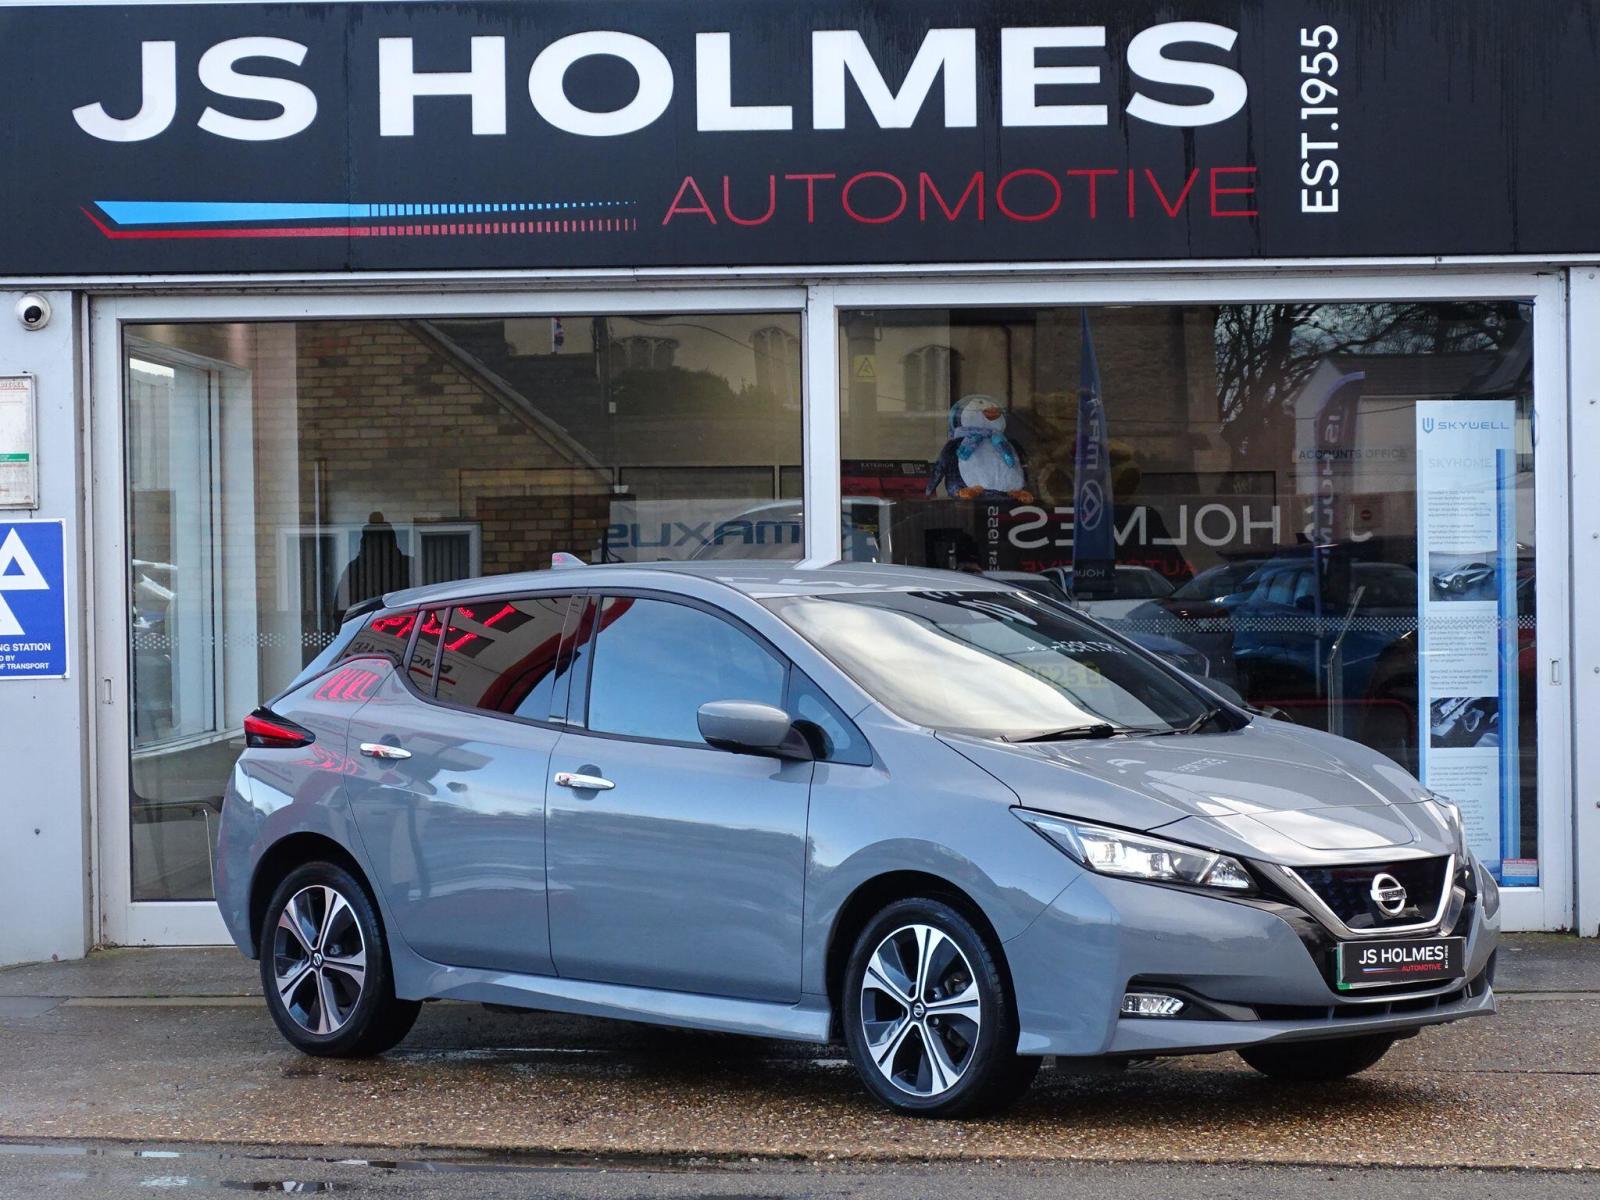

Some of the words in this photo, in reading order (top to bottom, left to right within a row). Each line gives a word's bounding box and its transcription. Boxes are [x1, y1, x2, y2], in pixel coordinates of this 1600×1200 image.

[72, 36, 318, 142] JS
[378, 21, 1248, 137] HOLMES
[662, 167, 1259, 226] AUTOMOTIVE
[1437, 421, 1510, 431] SKYWELL
[1427, 457, 1493, 469] SKYHOME
[12, 642, 51, 651] STATION
[7, 662, 49, 670] TRANSPORT
[1358, 949, 1377, 964] JS
[1381, 945, 1444, 963] HOLMES
[1402, 963, 1442, 972] AUTOMOTIVE
